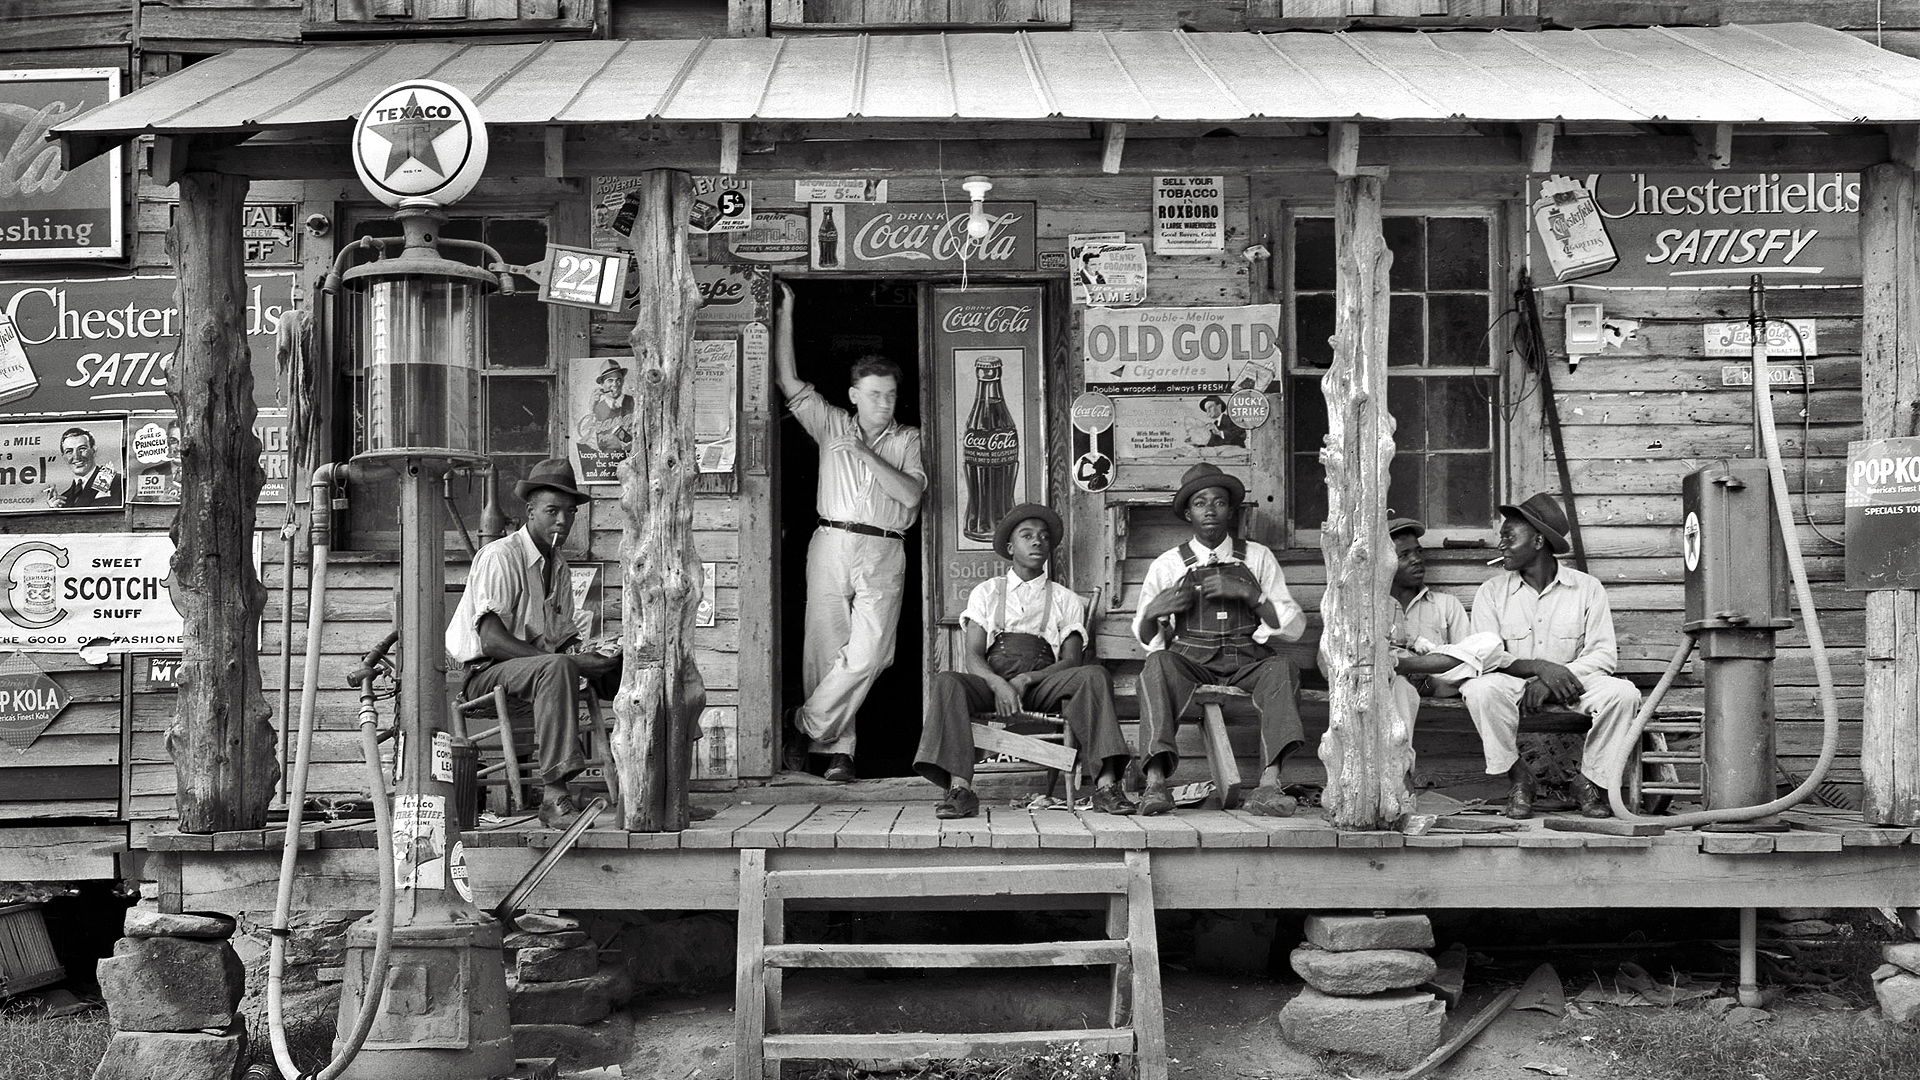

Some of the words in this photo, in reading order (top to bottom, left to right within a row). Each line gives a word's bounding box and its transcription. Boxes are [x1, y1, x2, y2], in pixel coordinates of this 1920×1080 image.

[376, 105, 452, 122] TEXACO
[1158, 188, 1218, 198] TOBACCO
[1585, 173, 1861, 219] Chesterfields
[897, 212, 947, 221] DRINK
[1158, 204, 1219, 219] ROXBORO
[0, 217, 94, 245] shing
[853, 212, 1022, 261] Coca-Cola
[1645, 228, 1819, 266] SATISFY
[1109, 253, 1136, 262] BENNY
[1103, 262, 1143, 272] GOODMAN
[700, 278, 742, 300] ape
[942, 305, 1032, 334] Coca-Cola
[1088, 324, 1164, 363] OLD
[1172, 323, 1278, 362] GOLD
[1133, 364, 1207, 378] Cigarettes
[1093, 385, 1120, 393] Double
[1167, 384, 1195, 394] always
[1197, 383, 1229, 392] FRESH!
[1233, 397, 1263, 406] LUCKY
[1073, 405, 1110, 418] Coca-Cola
[1231, 407, 1266, 417] STRIKE
[14, 436, 41, 446] MILE
[135, 439, 166, 449] PRINCELY
[964, 431, 1018, 450] Coca-Cola
[579, 451, 598, 460] keeps
[611, 450, 624, 460] pipe
[596, 459, 606, 467] the
[586, 469, 598, 478] and
[145, 476, 159, 485] 50
[1898, 485, 1917, 493] Finest
[1865, 506, 1904, 516] SPECIALS
[92, 558, 142, 568] SWEET
[949, 561, 987, 578] Sold
[64, 577, 158, 600] SCOTCH
[952, 584, 969, 600] Ic
[93, 608, 142, 619] SNUFF
[28, 636, 67, 644] GOOD
